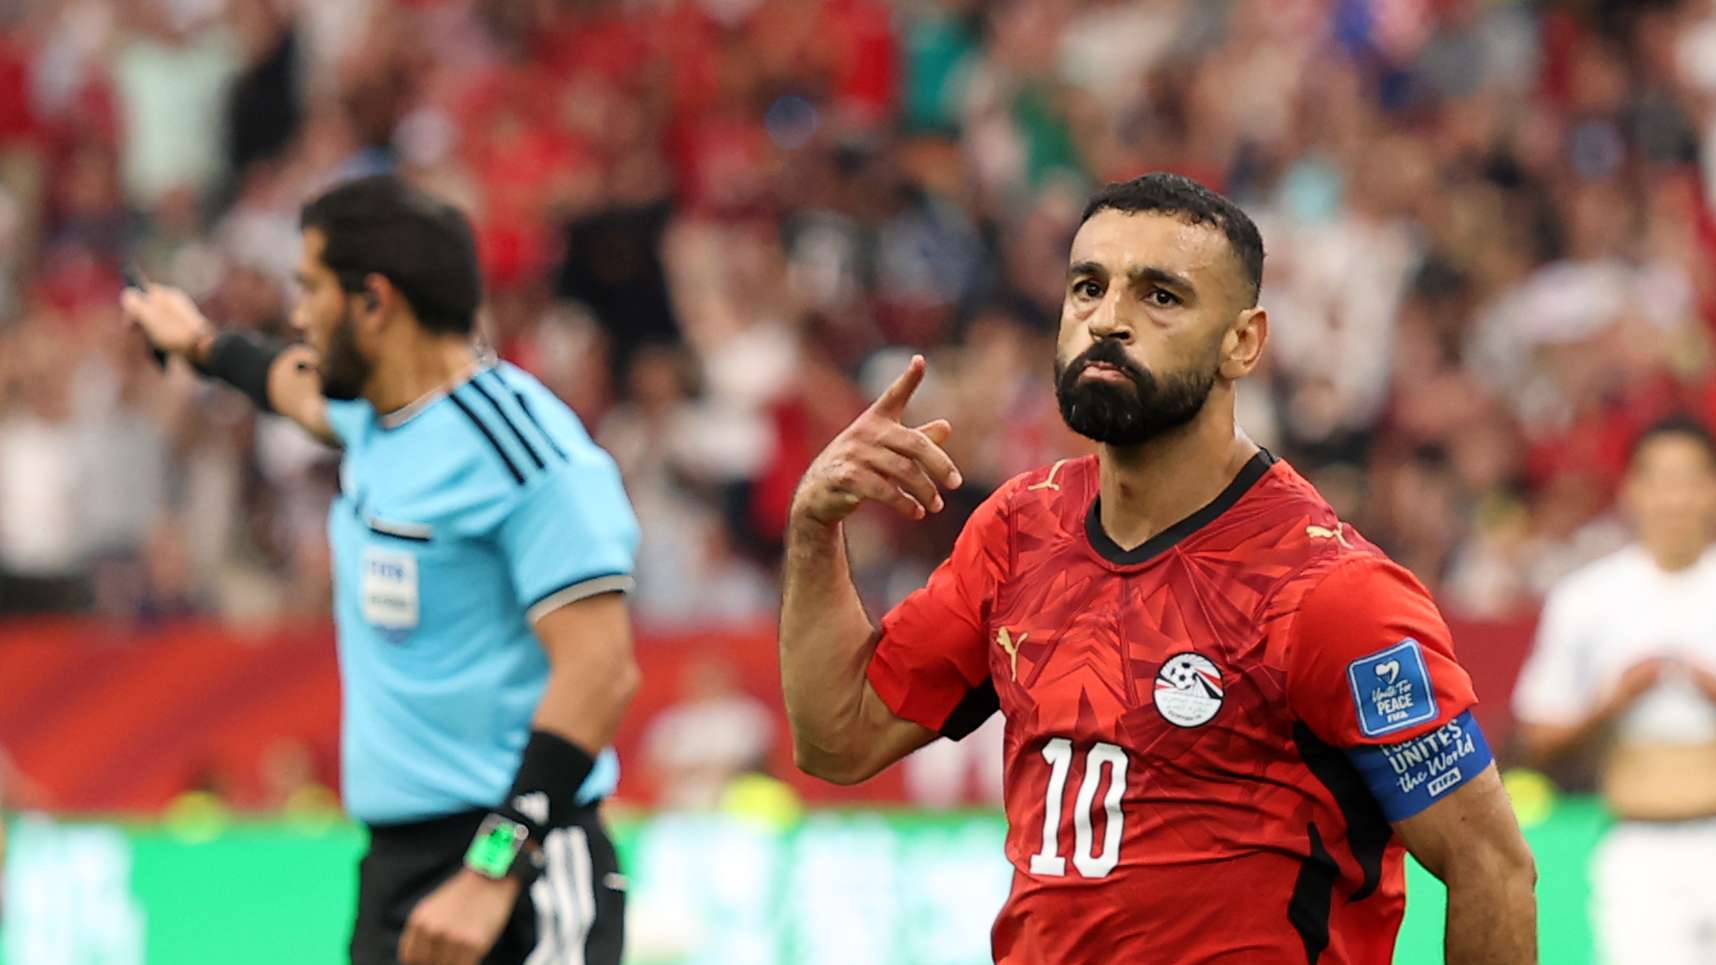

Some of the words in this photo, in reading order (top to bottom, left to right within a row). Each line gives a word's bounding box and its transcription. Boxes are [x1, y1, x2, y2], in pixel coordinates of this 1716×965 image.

[1376, 693, 1414, 716] PEACE
[1388, 718, 1462, 774] UNITES
[1396, 772, 1428, 793] the
[1425, 732, 1475, 776] World
[1029, 737, 1129, 878] 10
[1429, 769, 1461, 795] FIFA
